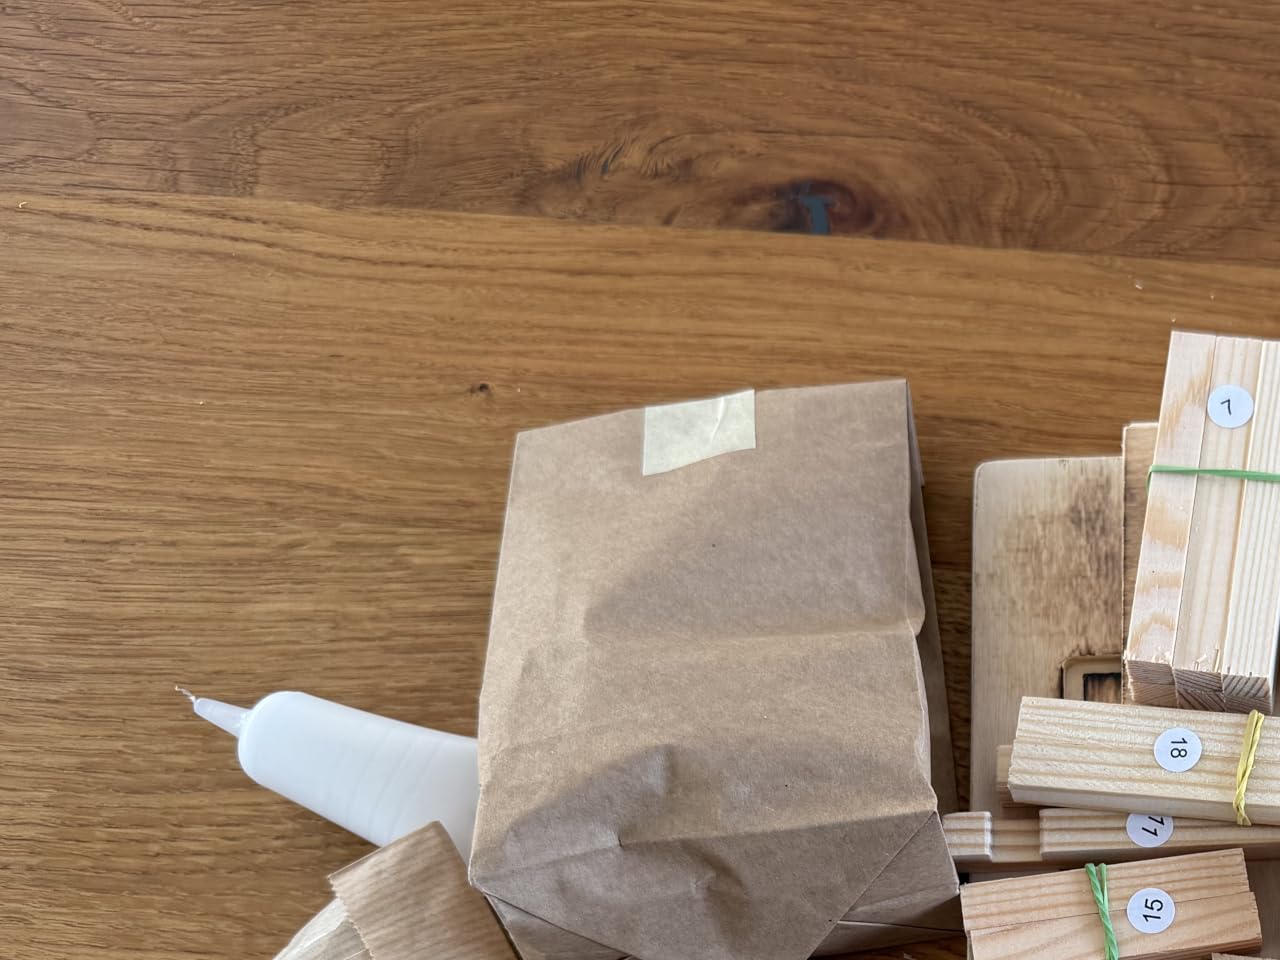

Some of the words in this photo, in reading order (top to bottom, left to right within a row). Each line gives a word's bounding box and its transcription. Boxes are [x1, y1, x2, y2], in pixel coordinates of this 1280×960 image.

[1220, 399, 1232, 416] 7
[1170, 737, 1188, 759] 18
[1142, 897, 1164, 922] 15
